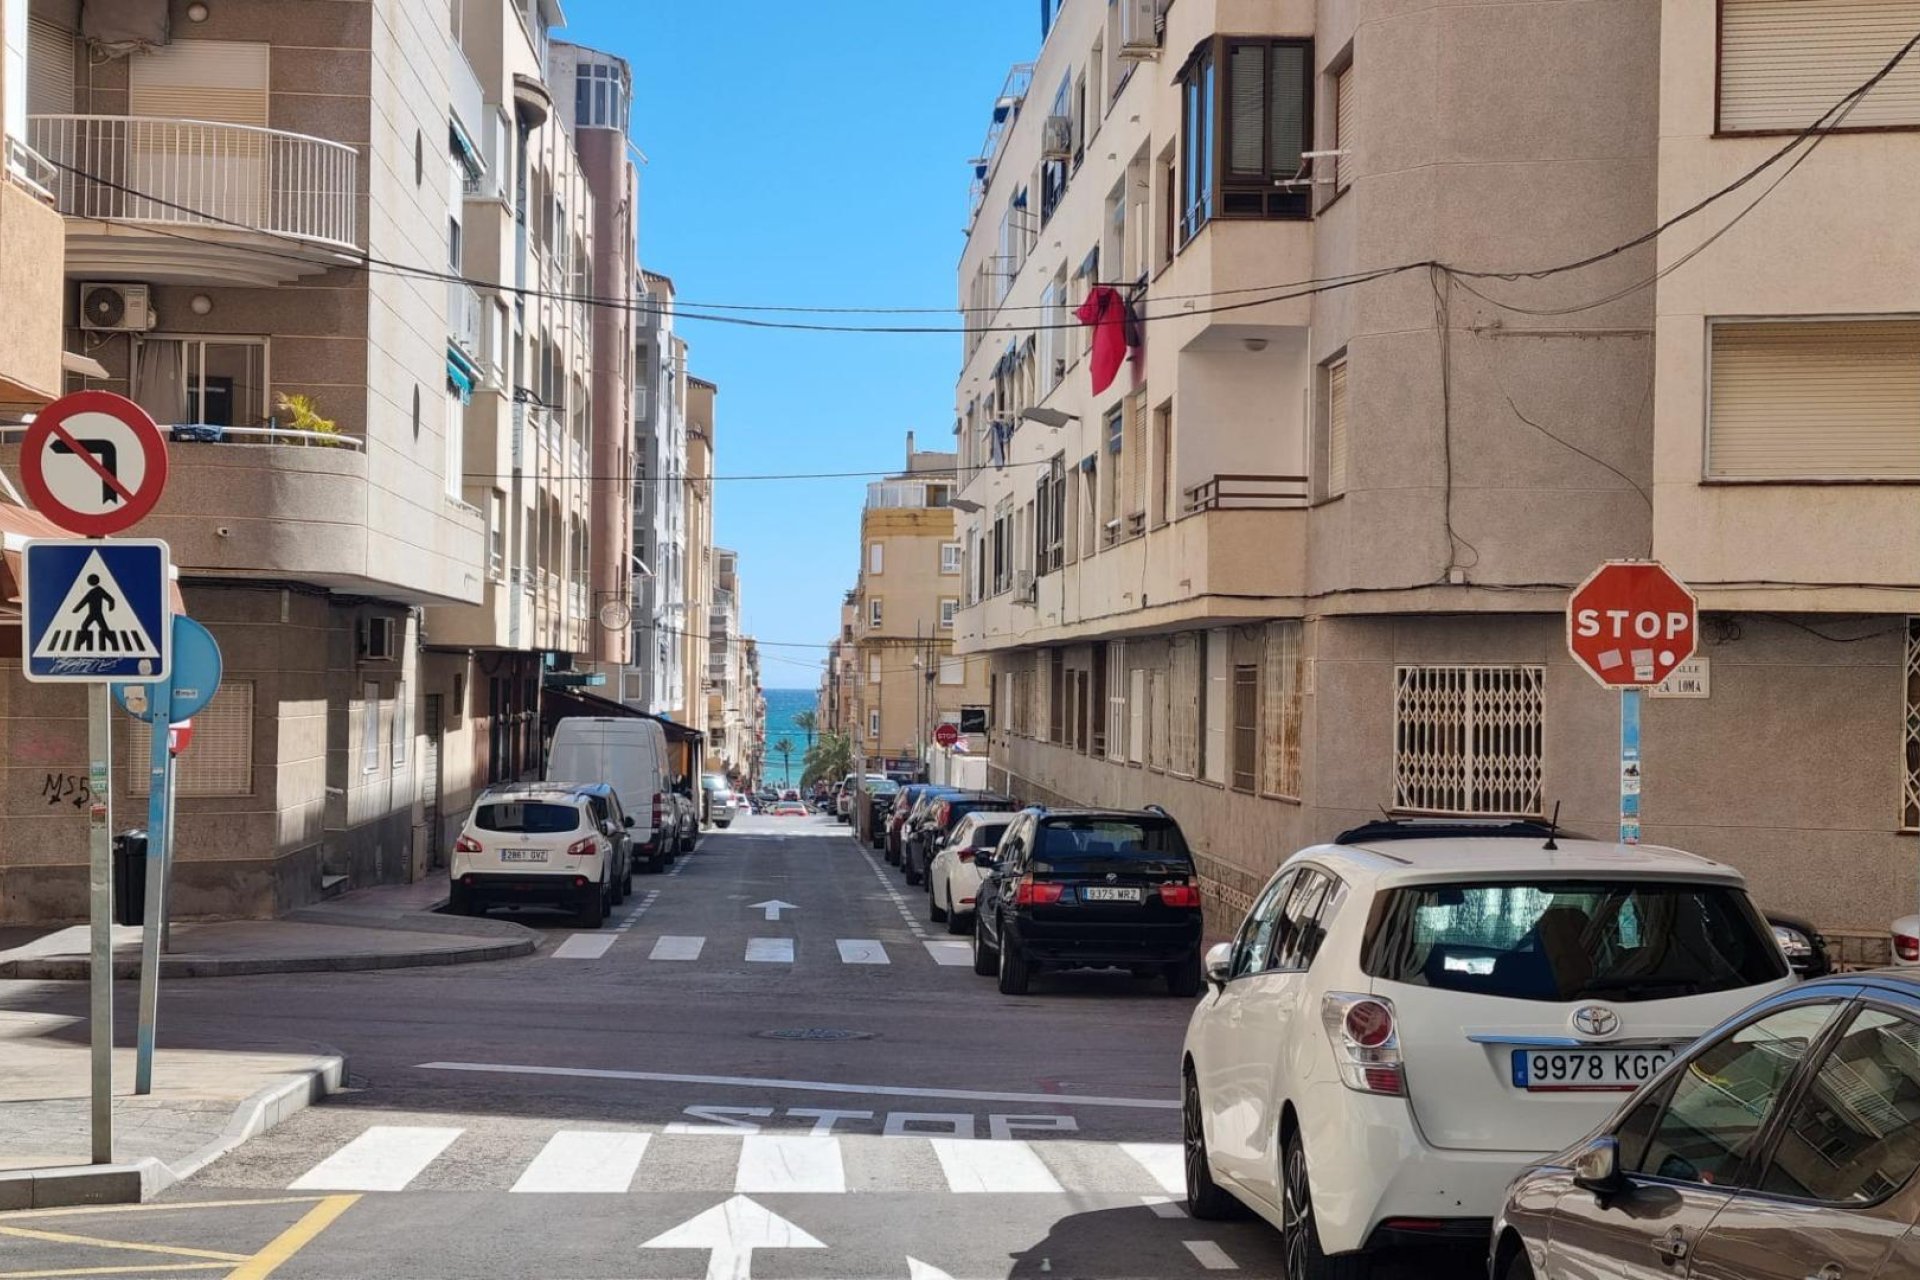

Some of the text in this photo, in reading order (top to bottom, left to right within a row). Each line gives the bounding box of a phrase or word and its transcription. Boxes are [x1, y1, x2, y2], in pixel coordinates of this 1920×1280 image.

[1577, 608, 1689, 640] STOP
[1678, 679, 1702, 692] LOMA
[937, 732, 957, 740] STOP
[1533, 1055, 1604, 1080] 9978
[663, 1105, 1080, 1140] STOP
